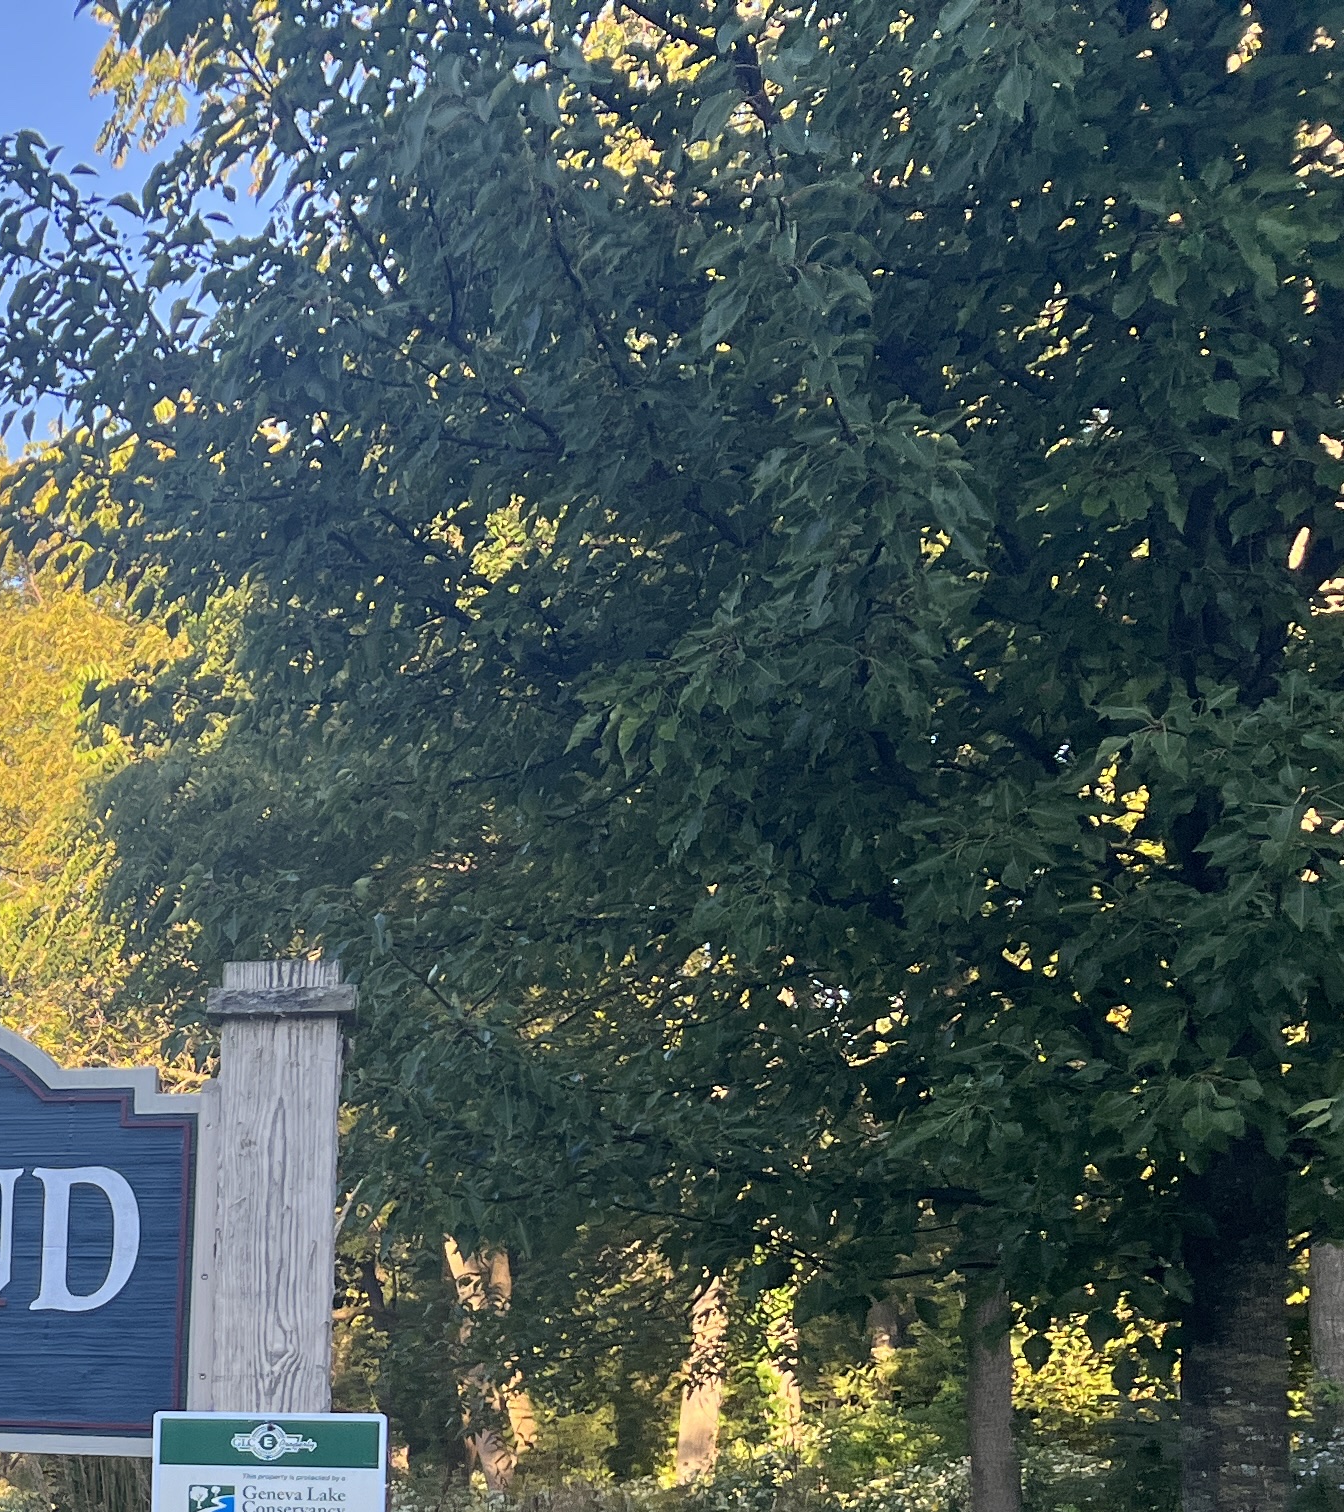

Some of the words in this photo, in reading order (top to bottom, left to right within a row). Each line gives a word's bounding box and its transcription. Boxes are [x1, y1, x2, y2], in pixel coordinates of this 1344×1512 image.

[263, 1436, 273, 1448] E
[242, 1485, 302, 1501] Geneva
[307, 1486, 346, 1502] Lake
